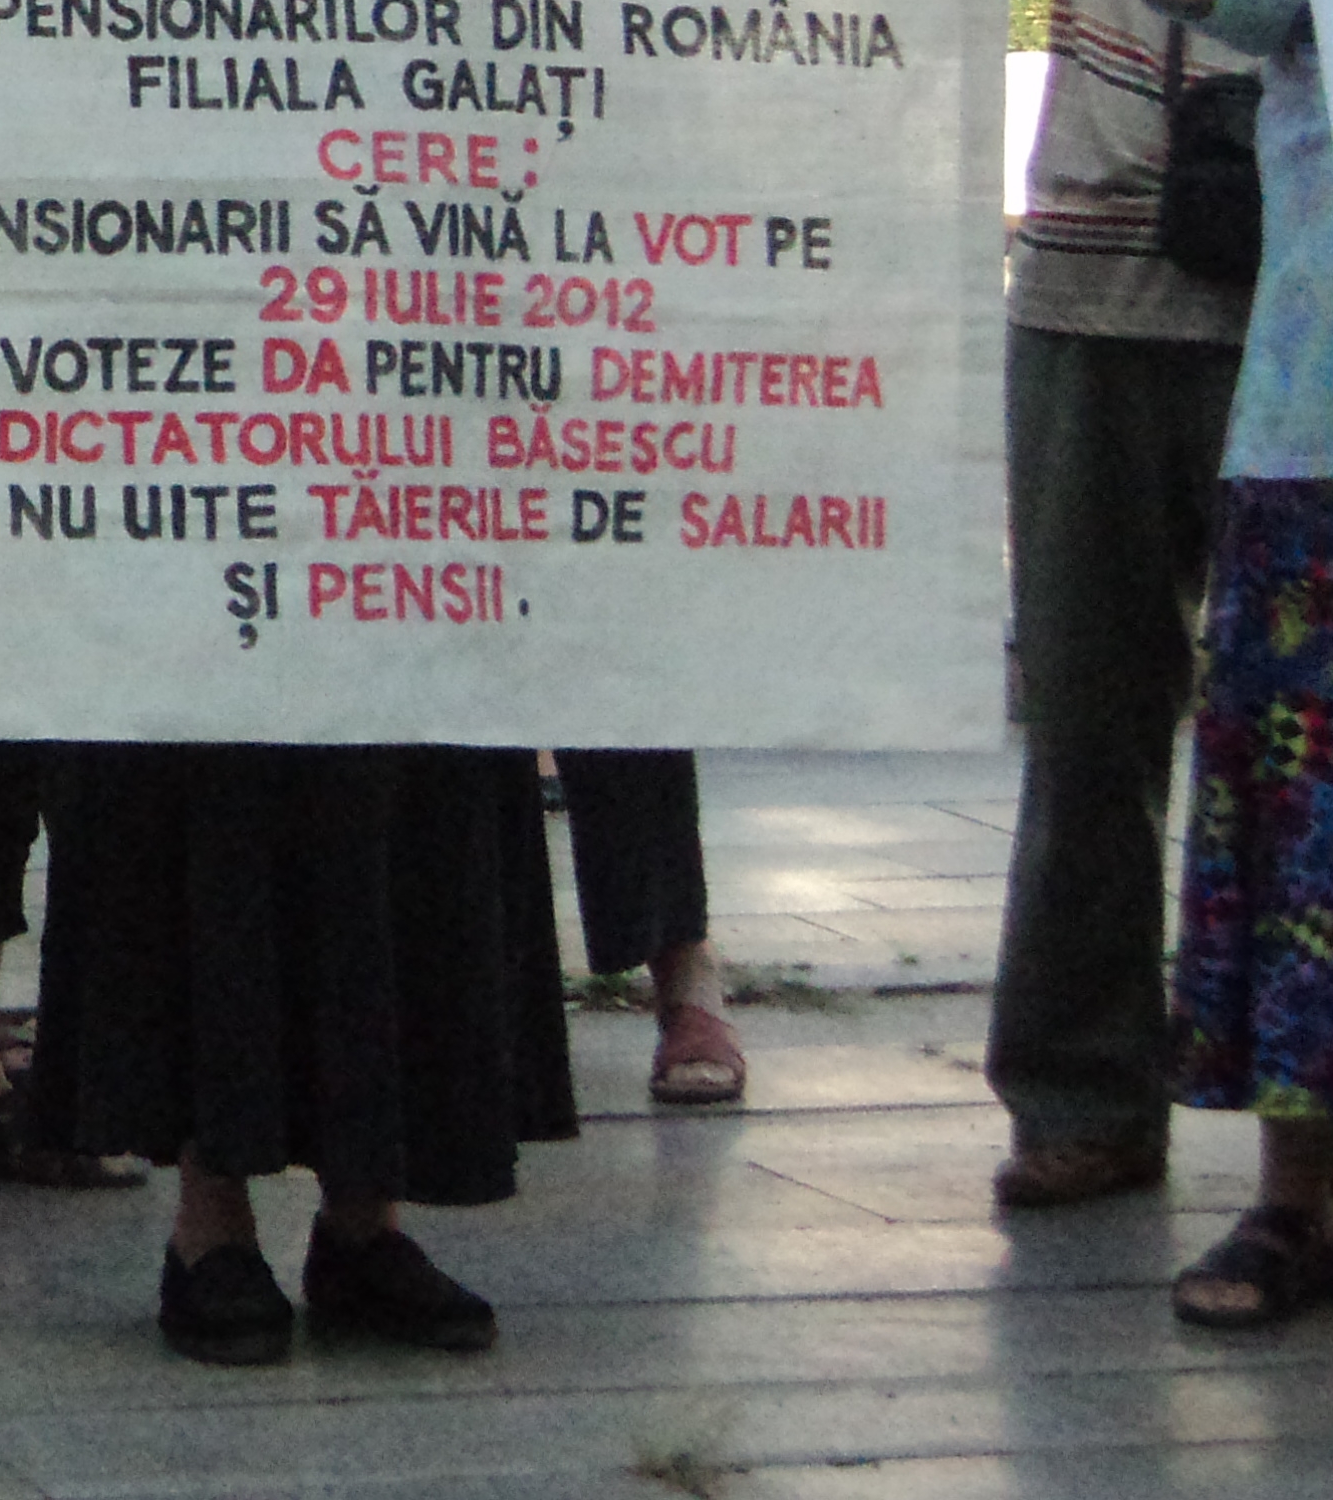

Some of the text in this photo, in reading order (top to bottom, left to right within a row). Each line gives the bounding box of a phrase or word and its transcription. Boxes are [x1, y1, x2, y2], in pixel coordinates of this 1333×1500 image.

[128, 55, 365, 111] FILIALA
[314, 184, 392, 256] SĂ
[405, 189, 531, 262] VINĂ
[554, 208, 614, 263] LA
[634, 213, 753, 266] VOT
[765, 216, 832, 269] PE
[259, 265, 657, 333] 29 IULIE 2012
[0, 337, 236, 394] VOTEZE
[263, 337, 351, 395] DA
[366, 340, 562, 401] PENTRU
[591, 347, 885, 408] DEMITEREA
[486, 403, 737, 474] BĂSESCU
[9, 483, 98, 541] NU
[122, 483, 278, 541] UITE
[307, 468, 550, 542] TĂIERILE
[571, 488, 647, 544] DE
[679, 491, 887, 550] SALARII
